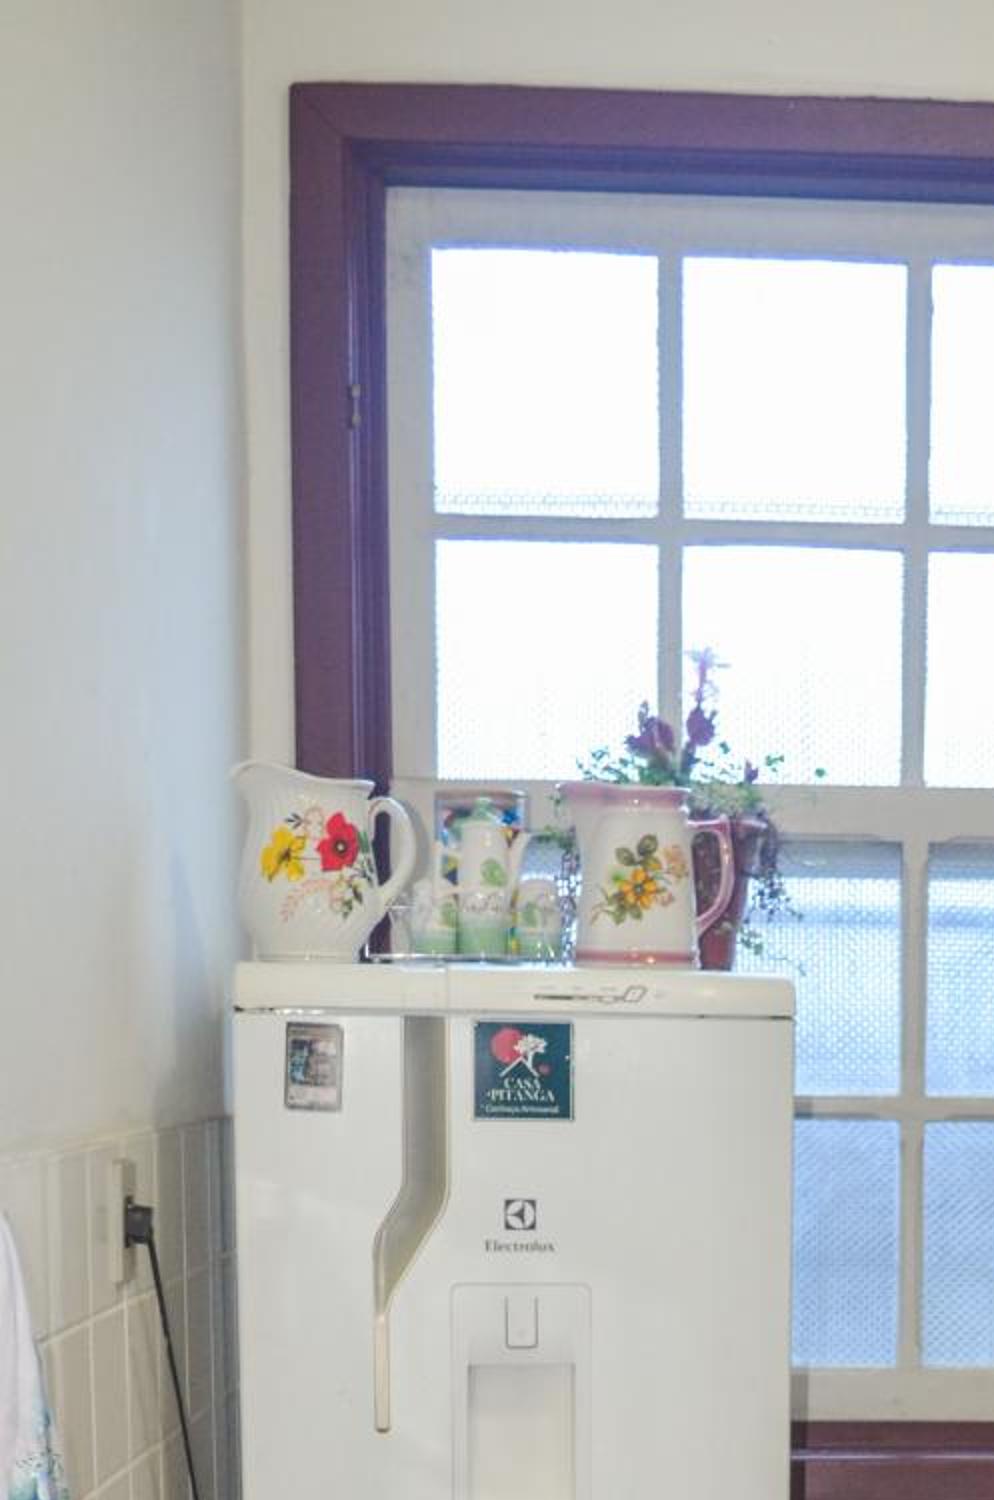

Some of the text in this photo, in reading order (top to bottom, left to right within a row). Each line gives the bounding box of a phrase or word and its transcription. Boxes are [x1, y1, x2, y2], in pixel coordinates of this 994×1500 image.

[503, 1078, 541, 1089] CASA
[490, 1088, 555, 1101] PITANGA
[484, 1239, 555, 1252] Electrolux
